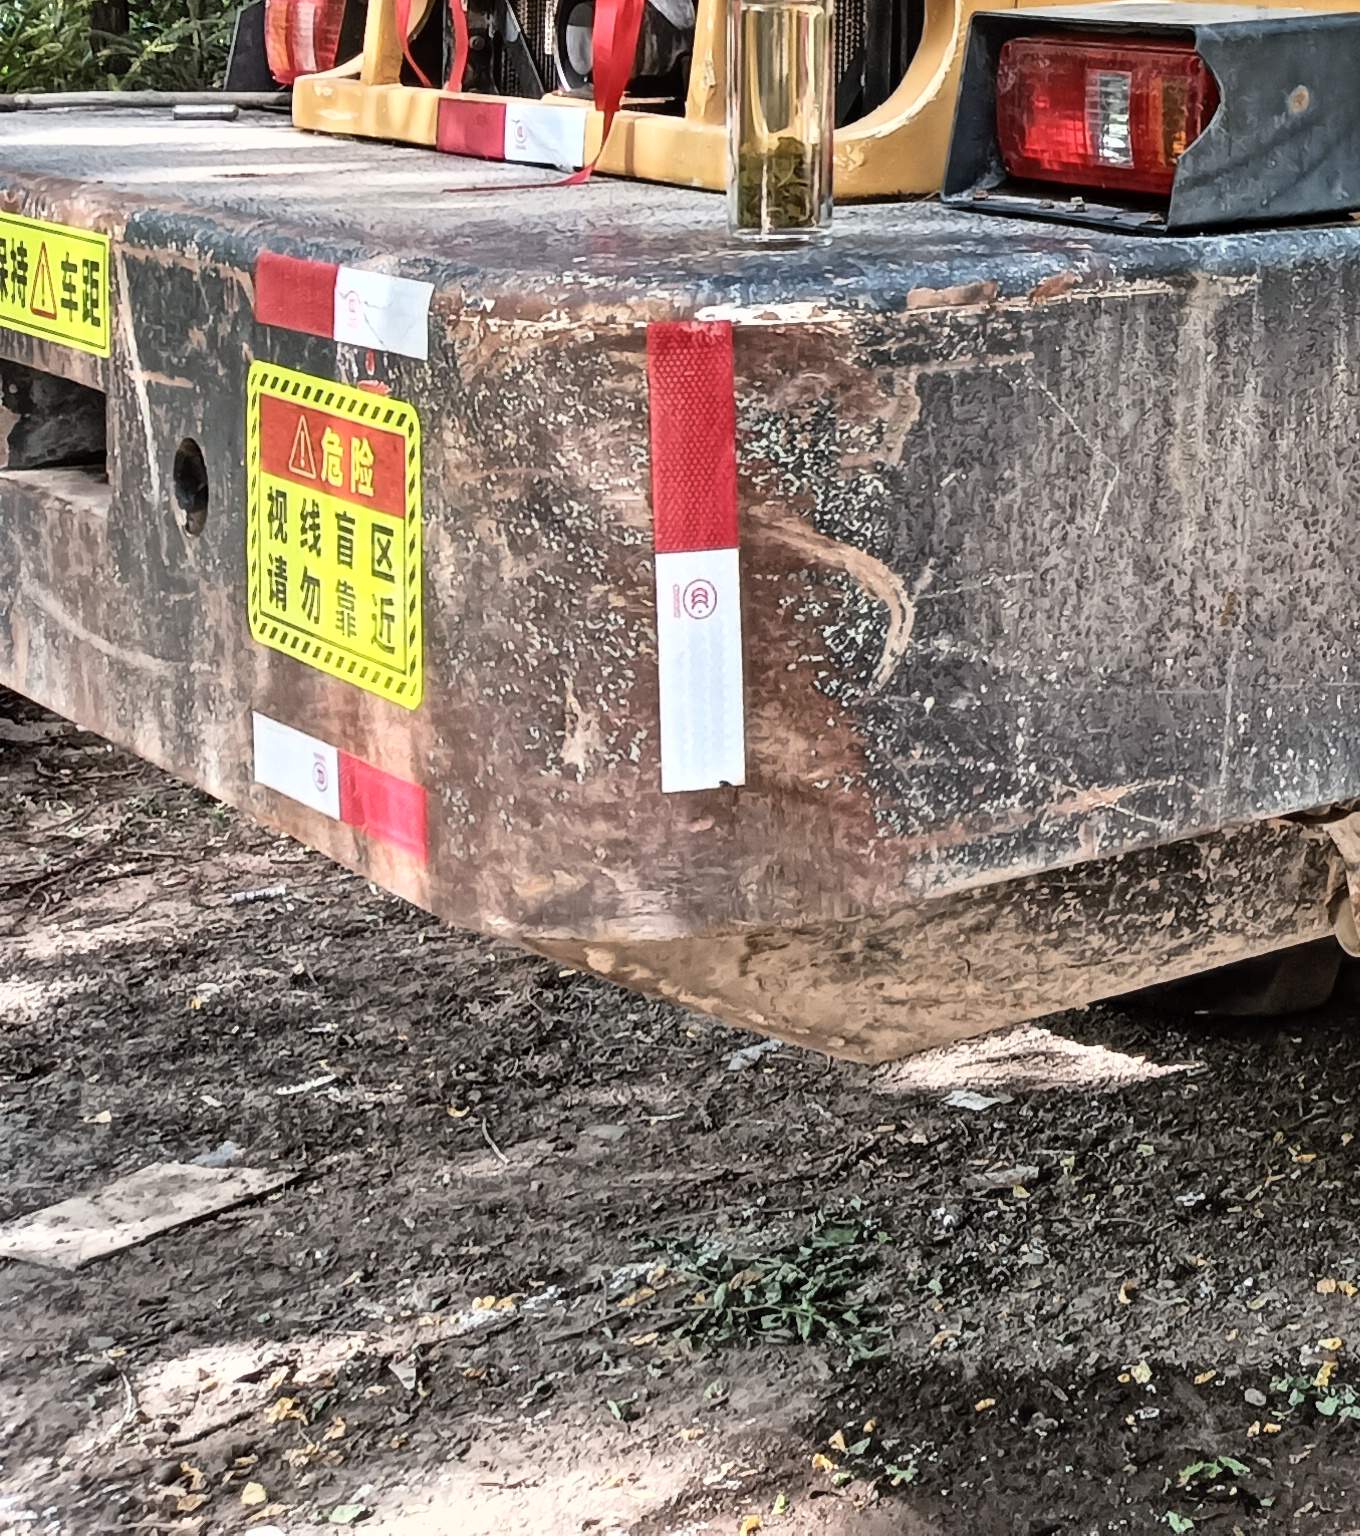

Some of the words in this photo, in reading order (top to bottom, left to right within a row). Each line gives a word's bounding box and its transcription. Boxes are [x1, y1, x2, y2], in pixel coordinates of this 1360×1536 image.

[320, 426, 376, 498] 危险
[266, 485, 397, 585] 视线盲区
[266, 552, 397, 656] 请勿靠近
